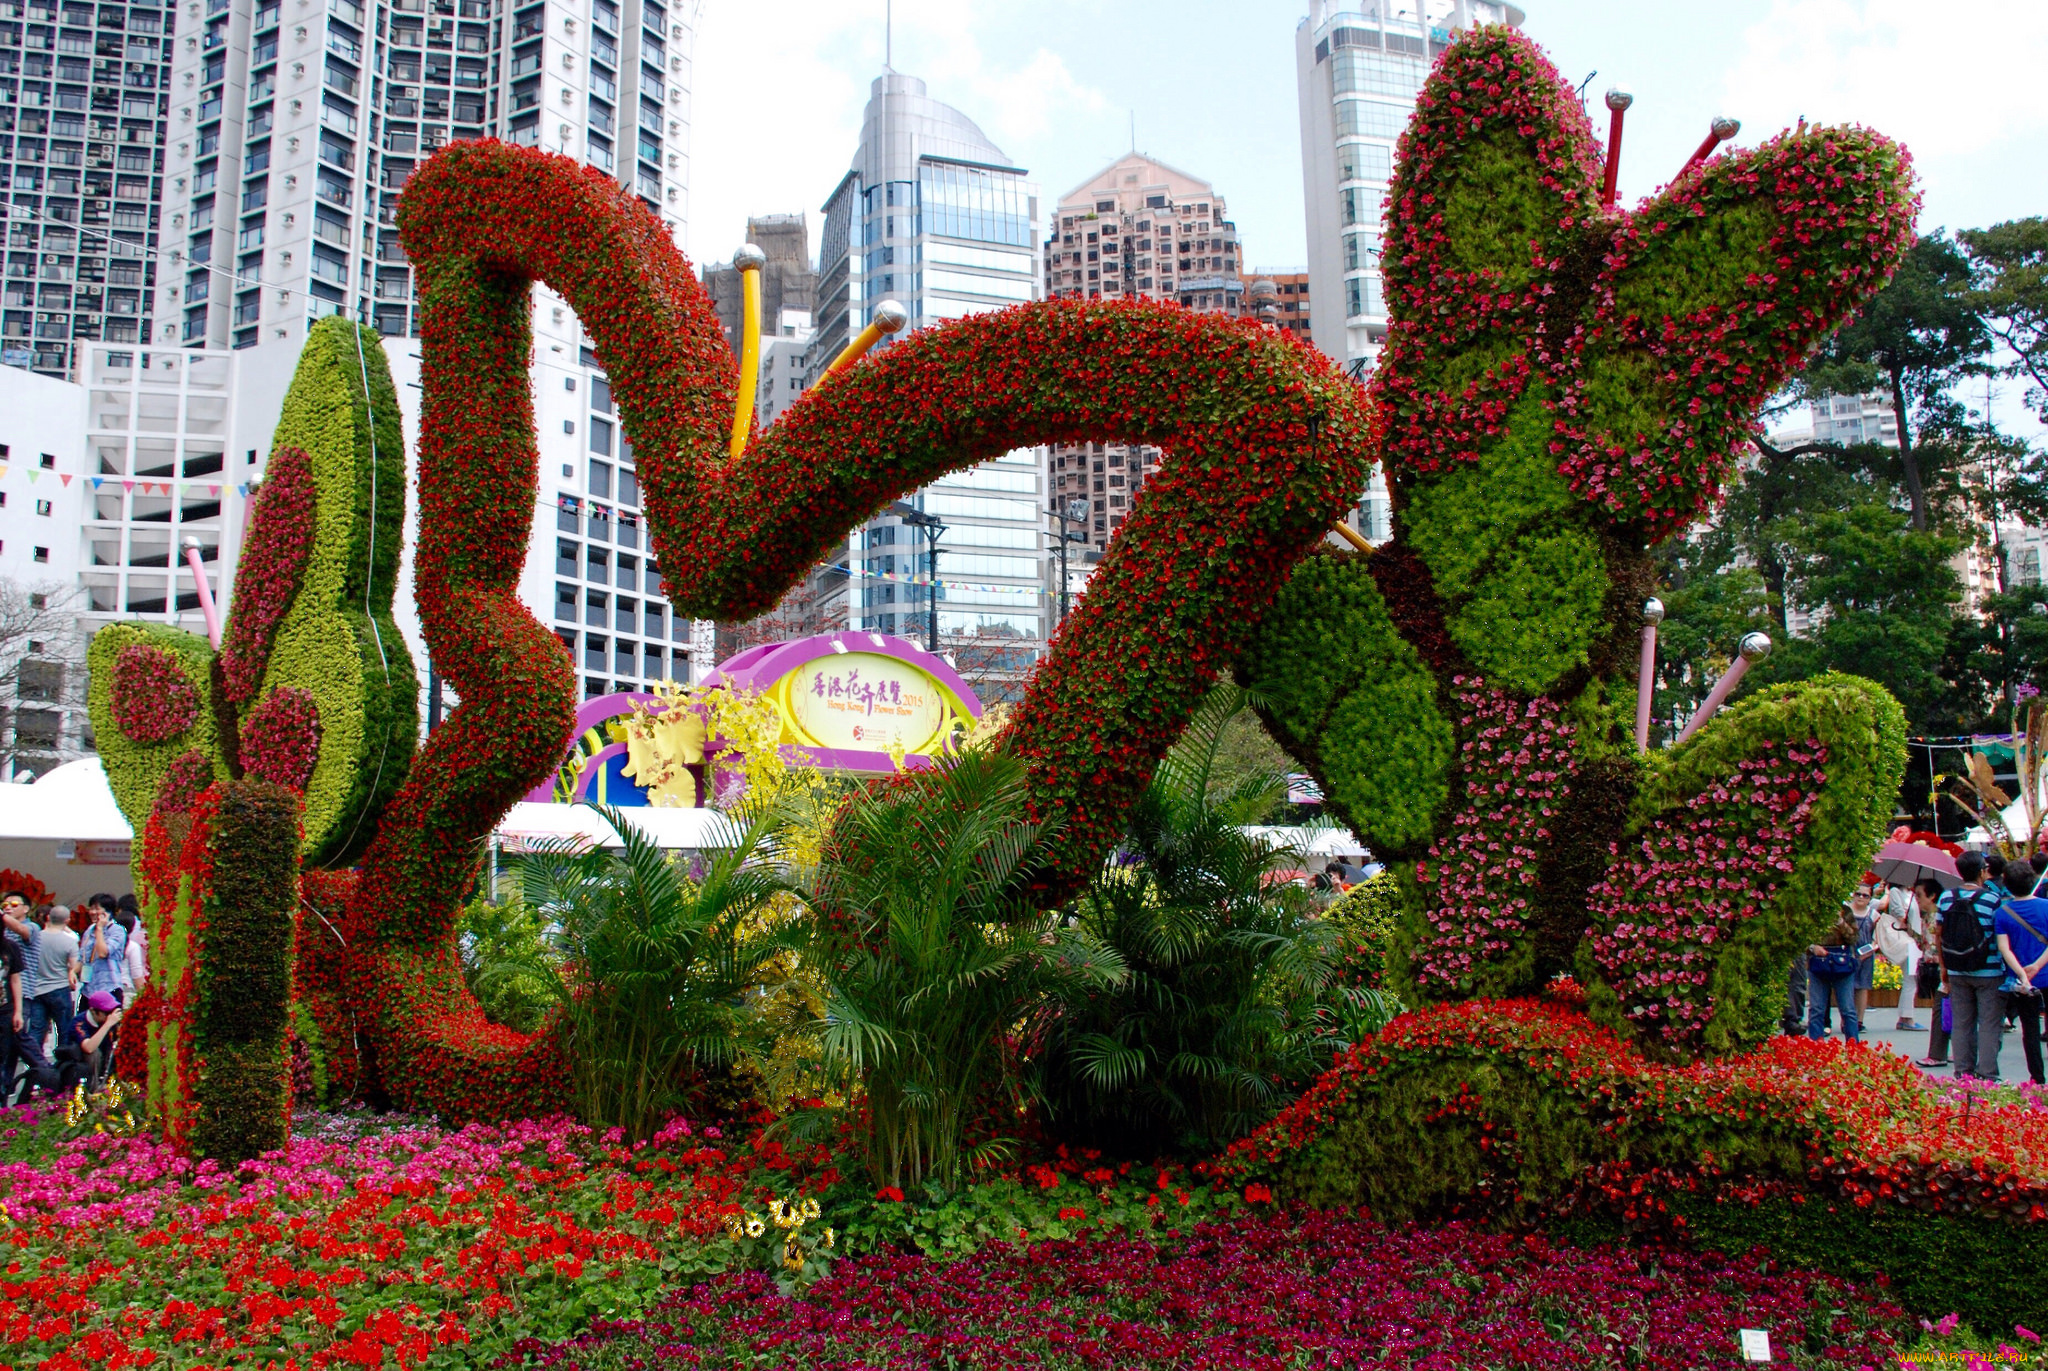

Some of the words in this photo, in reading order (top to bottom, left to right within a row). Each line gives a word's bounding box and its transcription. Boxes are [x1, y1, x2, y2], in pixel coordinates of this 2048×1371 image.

[827, 699, 846, 712] Hong
[847, 701, 865, 714] Kong
[874, 704, 894, 714] Flower
[896, 706, 913, 715] Show
[902, 694, 923, 708] 2015
